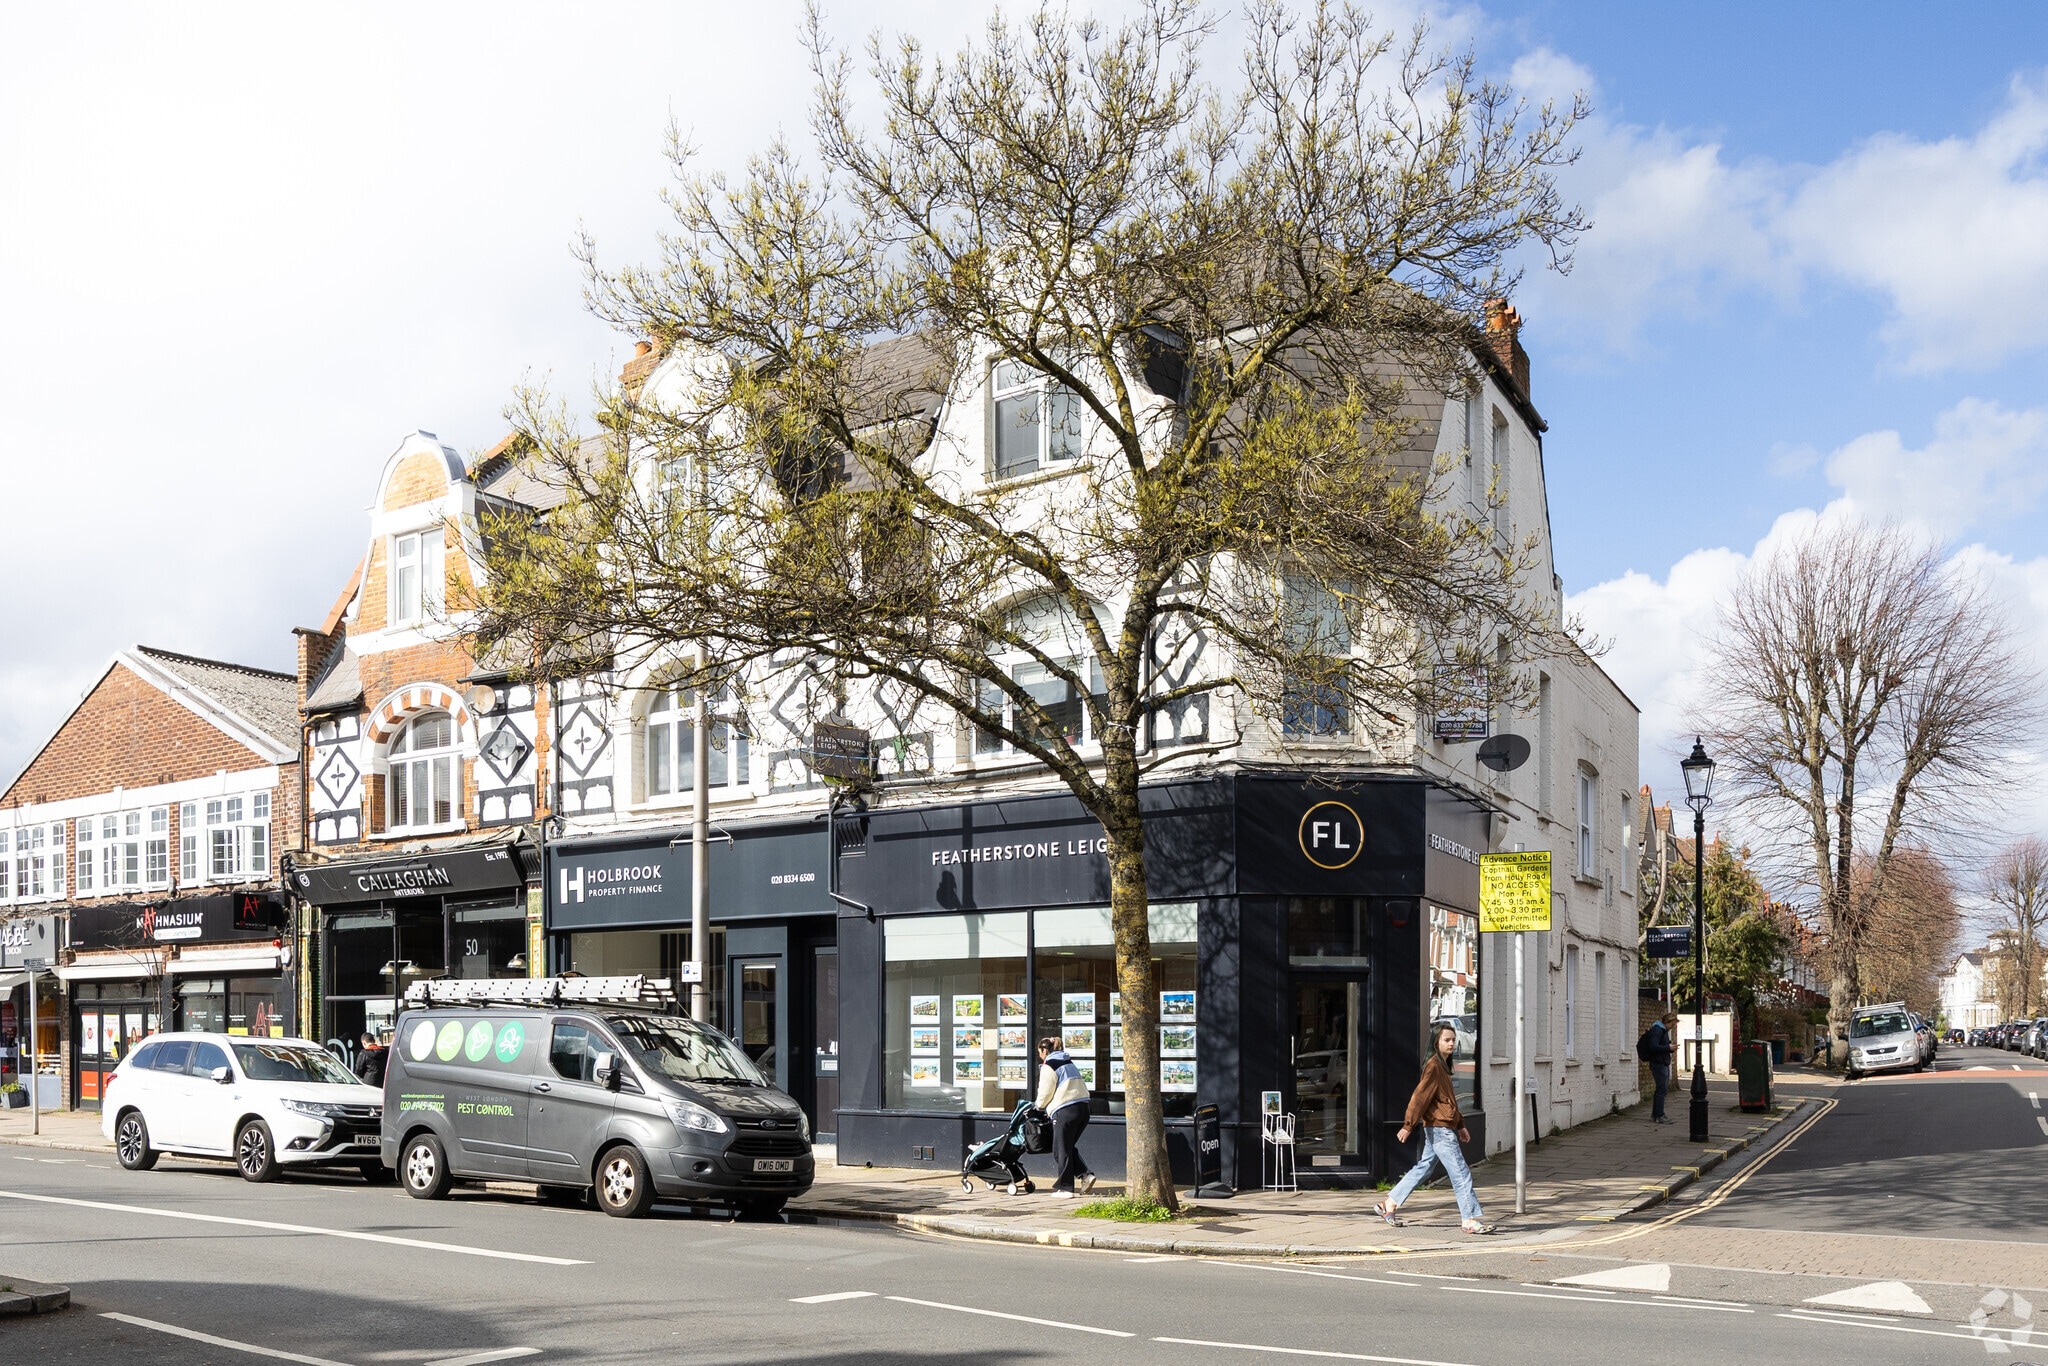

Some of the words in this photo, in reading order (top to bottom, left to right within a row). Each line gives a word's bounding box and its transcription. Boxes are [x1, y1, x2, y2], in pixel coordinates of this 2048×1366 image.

[816, 735, 865, 748] FEATHERSTONE
[816, 742, 837, 750] LEIGH
[1313, 822, 1350, 849] FL
[932, 841, 1060, 866] FEATHERSTONE
[1067, 838, 1108, 856] LEIG
[1431, 834, 1472, 862] FEATHERSTONE
[495, 851, 508, 860] 1992
[1483, 855, 1518, 863] Advance
[1520, 853, 1548, 862] Notice
[1482, 865, 1515, 874] Copthall
[1517, 864, 1548, 872] Gardens
[357, 867, 450, 892] CALLAGHAN
[587, 865, 662, 884] HOLBROOK
[771, 875, 783, 884] 020
[783, 874, 799, 883] 8334
[799, 873, 815, 882] 6500
[1526, 872, 1546, 880] Road
[560, 867, 584, 904] H
[1506, 881, 1540, 889] ACCESS
[393, 887, 425, 897] INTERIORS
[588, 887, 627, 897] PROPERTY
[629, 884, 663, 894] FINANCE
[1487, 907, 1505, 915] 2.00
[1511, 906, 1530, 914] 3.30
[1510, 914, 1548, 922] Permitted
[465, 938, 478, 956] 50
[482, 1095, 508, 1103] LONDON
[400, 1101, 411, 1111] 020
[457, 1103, 475, 1114] PEST
[357, 1135, 377, 1145] WV66
[1201, 1138, 1219, 1155] Open
